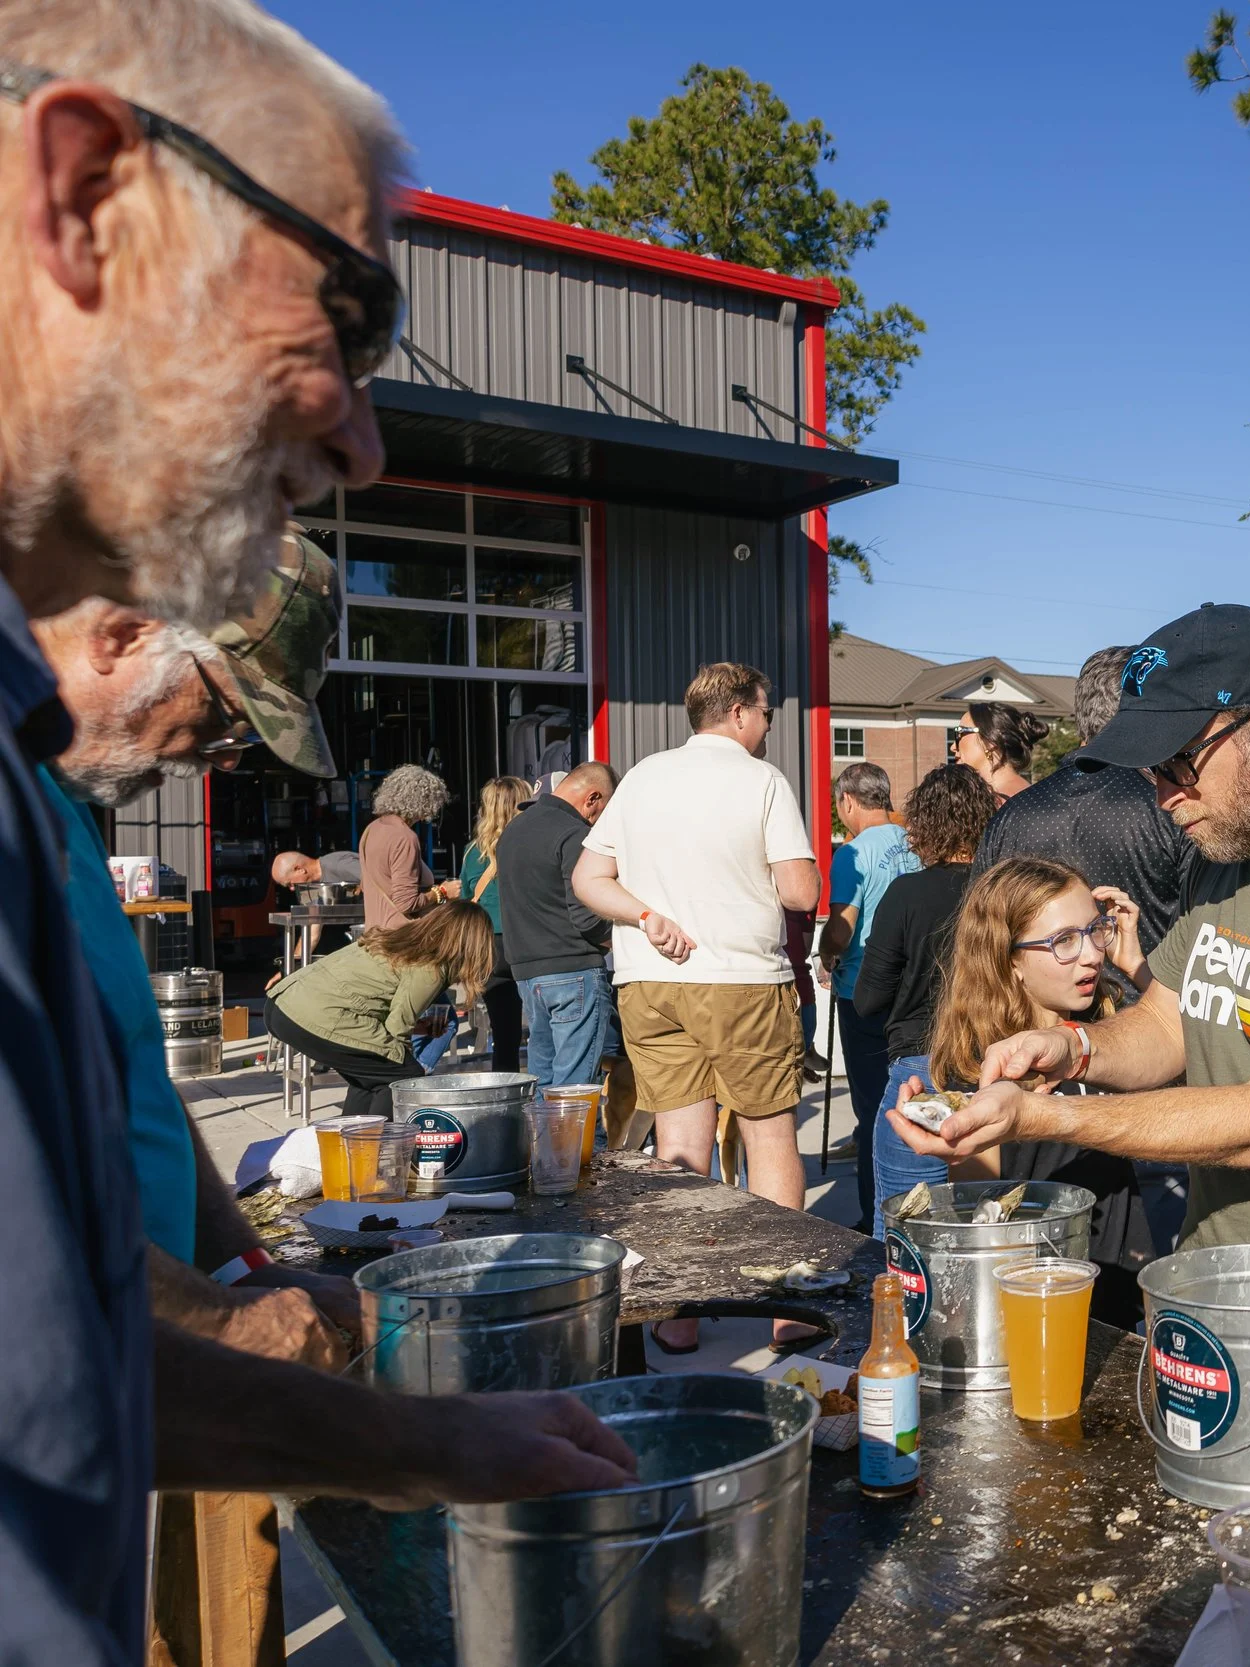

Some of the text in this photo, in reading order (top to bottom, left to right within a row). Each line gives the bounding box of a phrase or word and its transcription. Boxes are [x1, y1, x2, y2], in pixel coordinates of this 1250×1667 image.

[415, 1134, 455, 1143] EHRENS
[1155, 1353, 1217, 1387] BEHRENS
[1162, 1374, 1204, 1397] METALWARE
